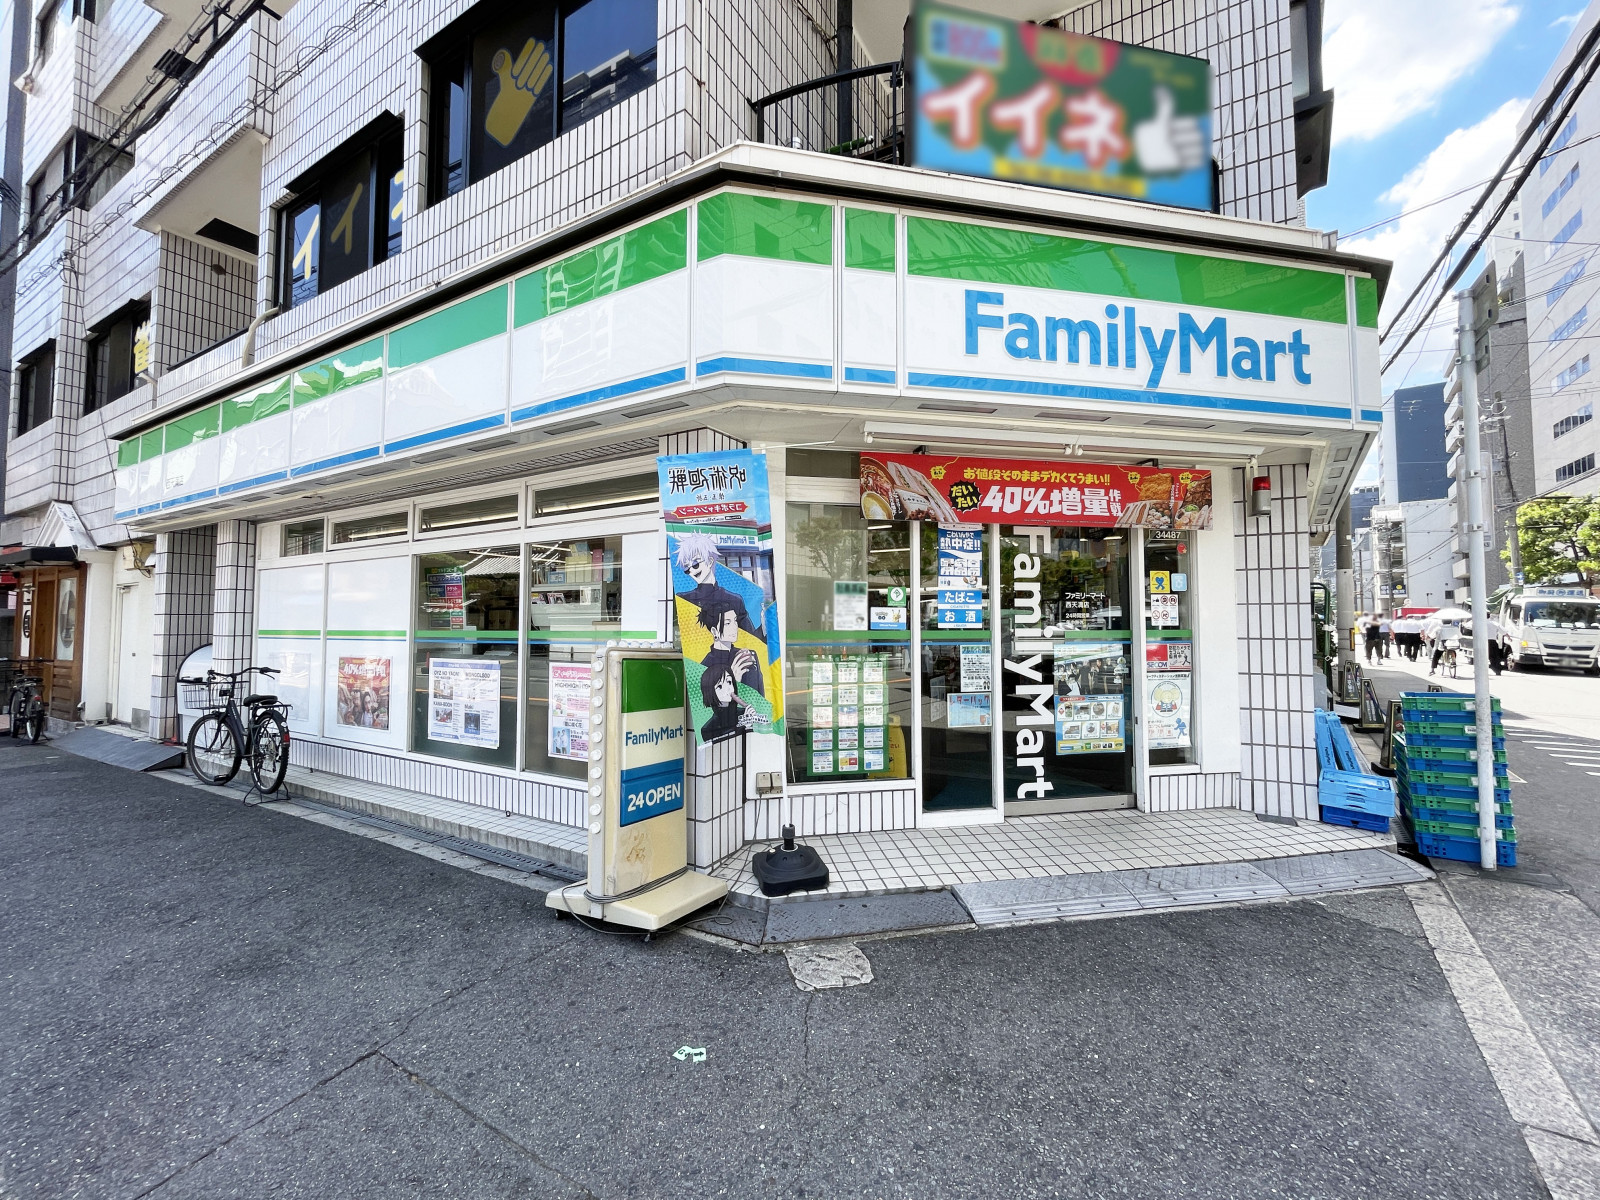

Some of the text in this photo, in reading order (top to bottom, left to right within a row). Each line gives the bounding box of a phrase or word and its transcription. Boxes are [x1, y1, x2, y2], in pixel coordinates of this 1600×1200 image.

[964, 289, 1312, 389] FamilyMart
[951, 485, 974, 497] だい
[956, 496, 979, 509] たい
[1155, 530, 1181, 539] 34487
[944, 591, 976, 603] たばこ
[1065, 592, 1106, 600] ファミリーマート
[1003, 526, 1055, 800] FamilyMart
[1147, 661, 1168, 669] SECOM
[625, 724, 684, 747] FamilyMart
[627, 783, 681, 812] 24 OPEN
